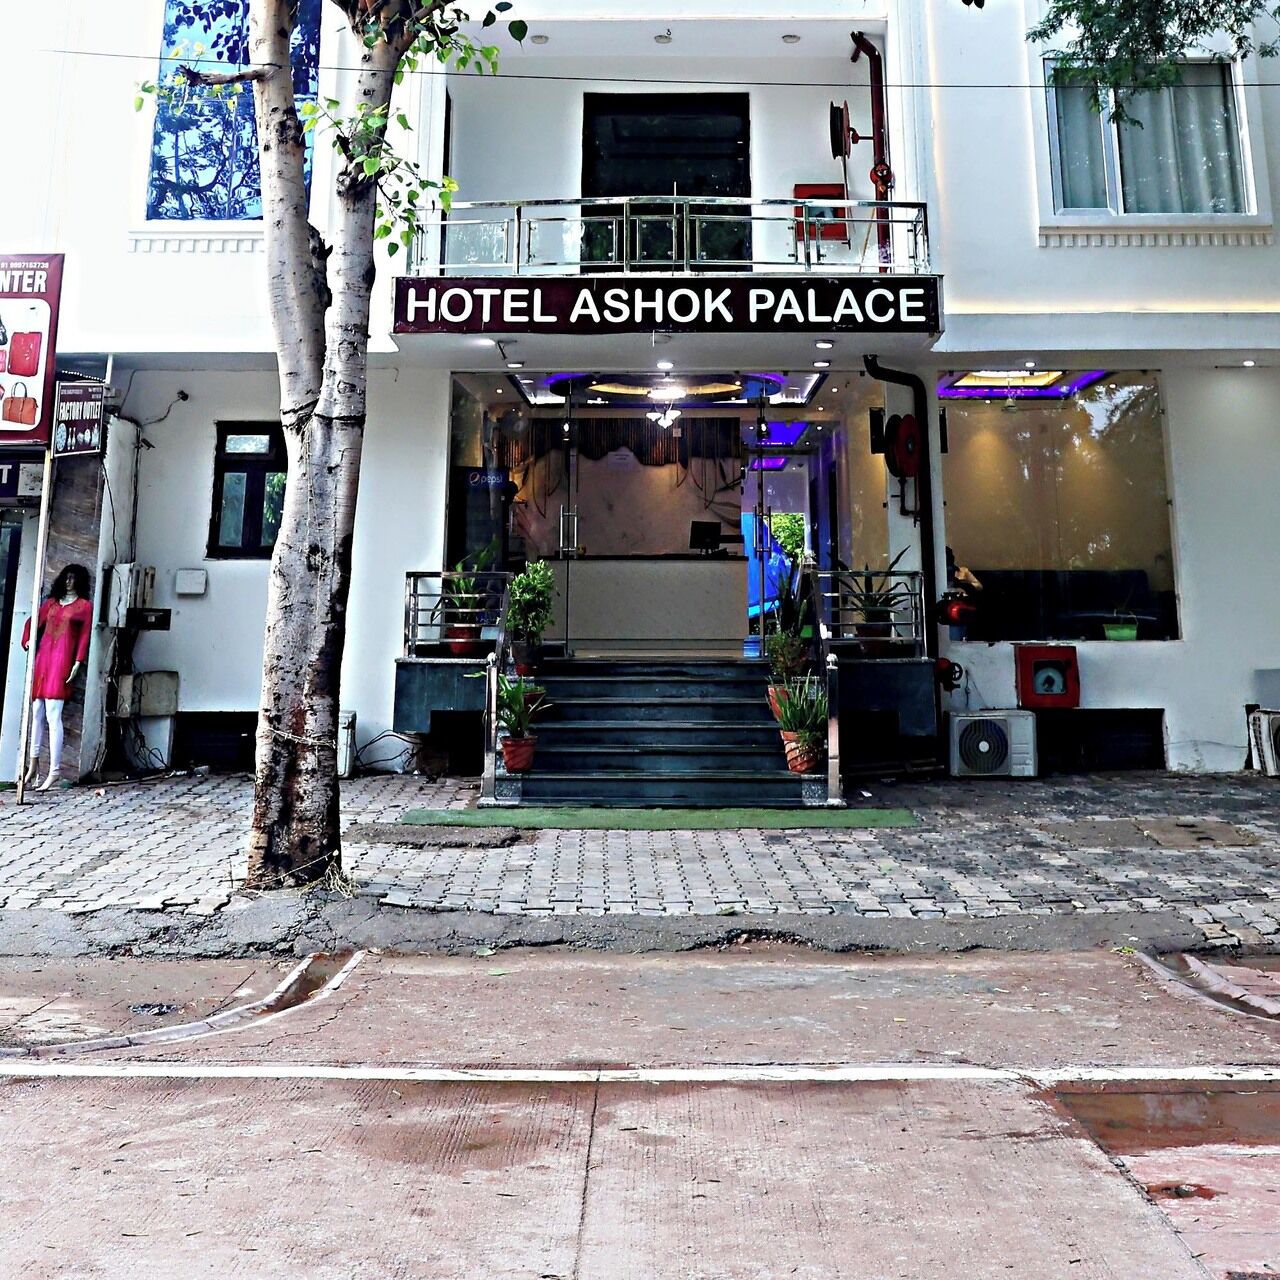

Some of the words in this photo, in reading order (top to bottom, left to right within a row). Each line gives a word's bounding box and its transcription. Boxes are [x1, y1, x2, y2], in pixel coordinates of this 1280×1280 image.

[406, 287, 558, 323] HOTEL
[570, 287, 734, 323] ASHOK
[749, 287, 927, 323] PALACE
[58, 401, 83, 421] FACTORY
[83, 401, 101, 420] OUTLET
[480, 475, 503, 484] pepsi
